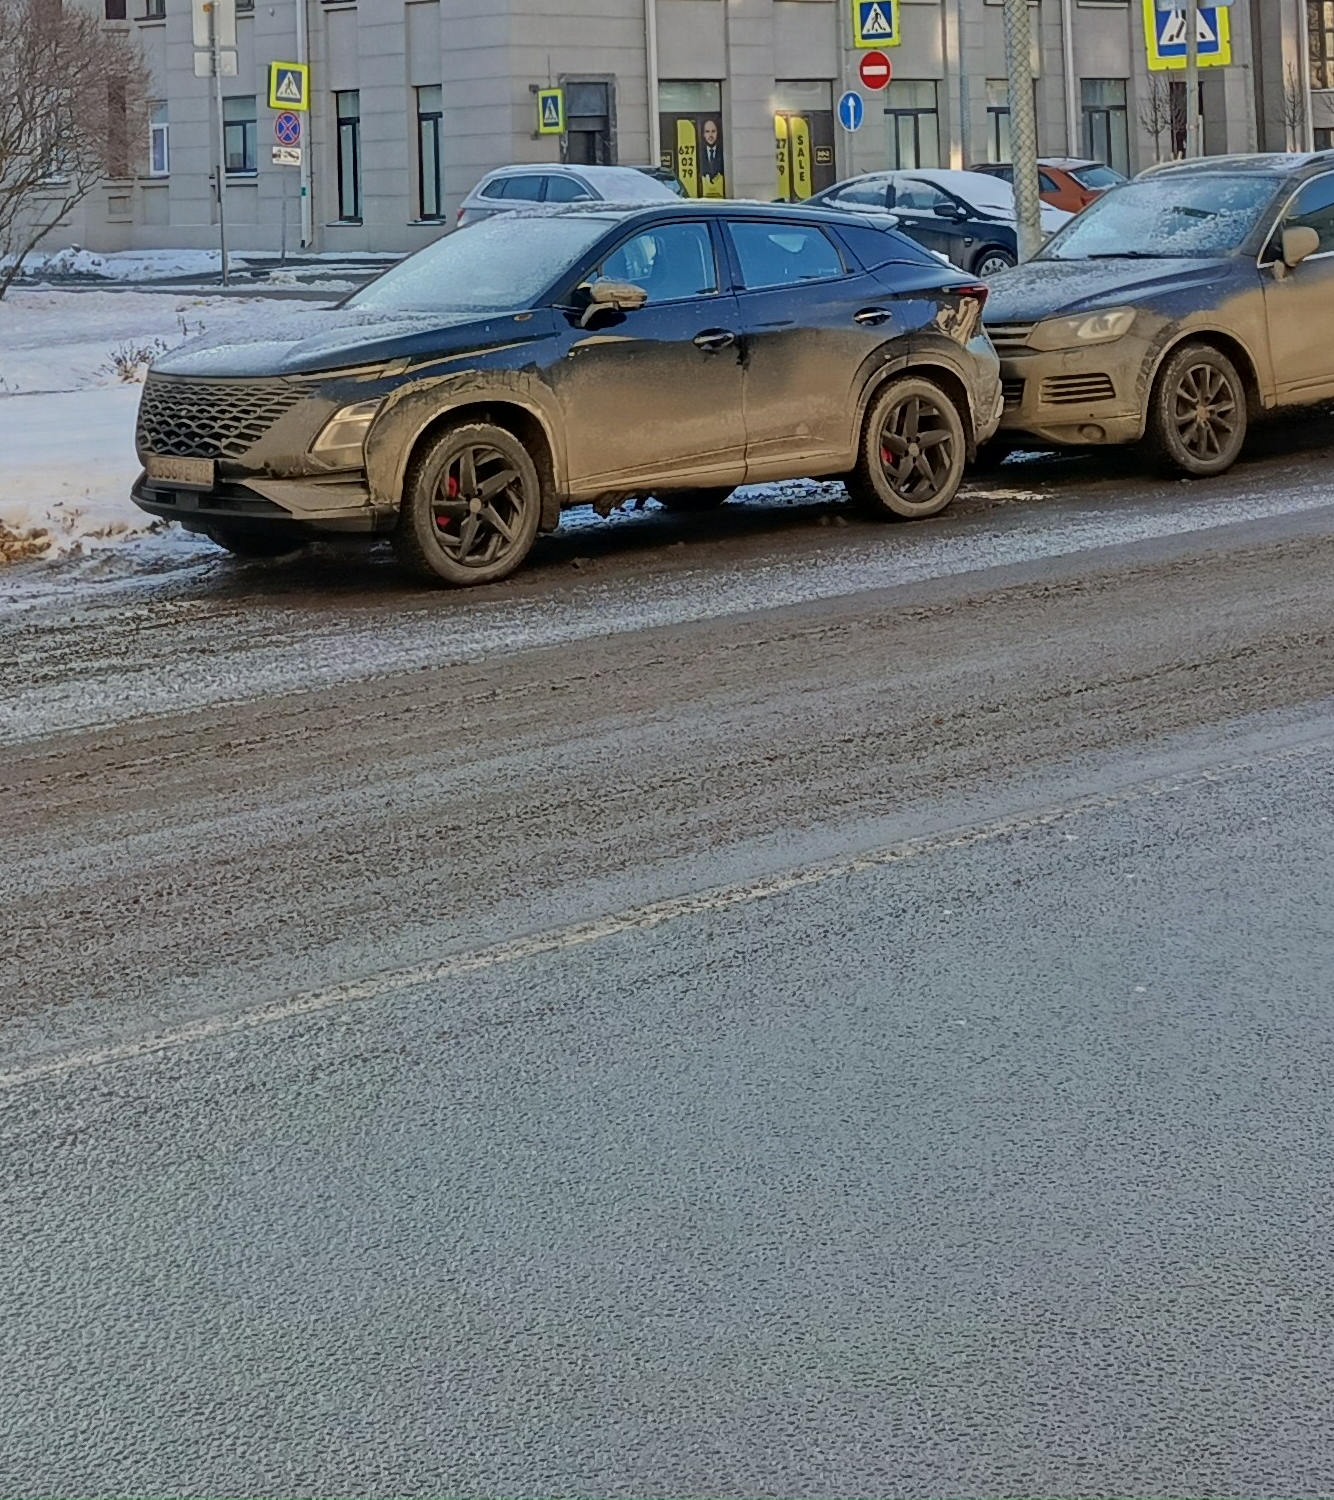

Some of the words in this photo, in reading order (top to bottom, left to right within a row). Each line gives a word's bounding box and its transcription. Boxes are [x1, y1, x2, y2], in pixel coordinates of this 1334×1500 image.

[679, 145, 695, 155] 627
[681, 157, 693, 166] 02
[797, 135, 805, 181] SALE
[682, 169, 693, 178] 79
